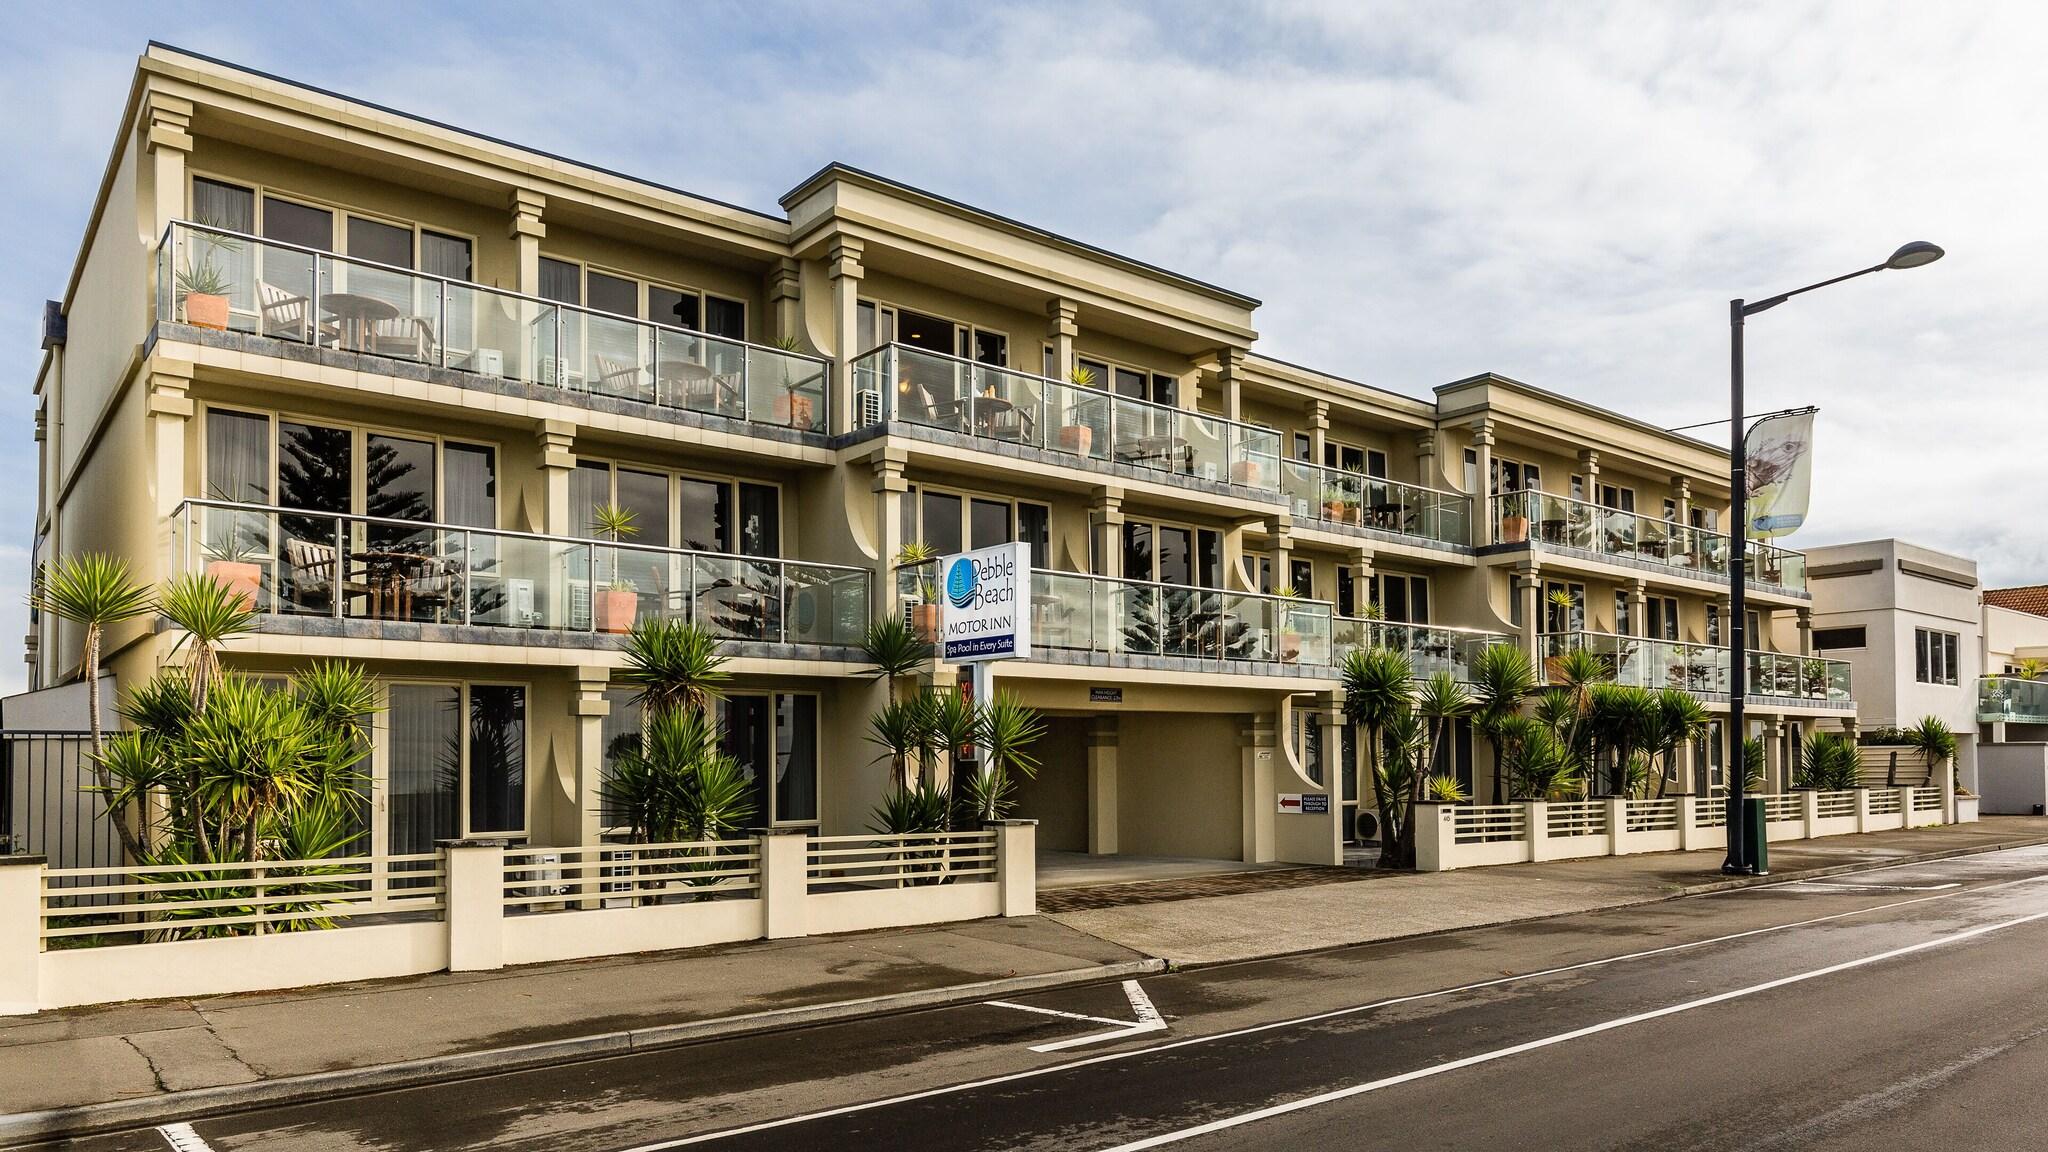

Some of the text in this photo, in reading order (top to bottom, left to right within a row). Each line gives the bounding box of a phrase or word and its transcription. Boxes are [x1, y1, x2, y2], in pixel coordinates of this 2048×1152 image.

[972, 553, 1013, 587] Pebble
[974, 577, 1014, 611] Beach
[948, 615, 1012, 636] MOTOR INN
[946, 638, 1013, 656] Spa Pool in Every Suite
